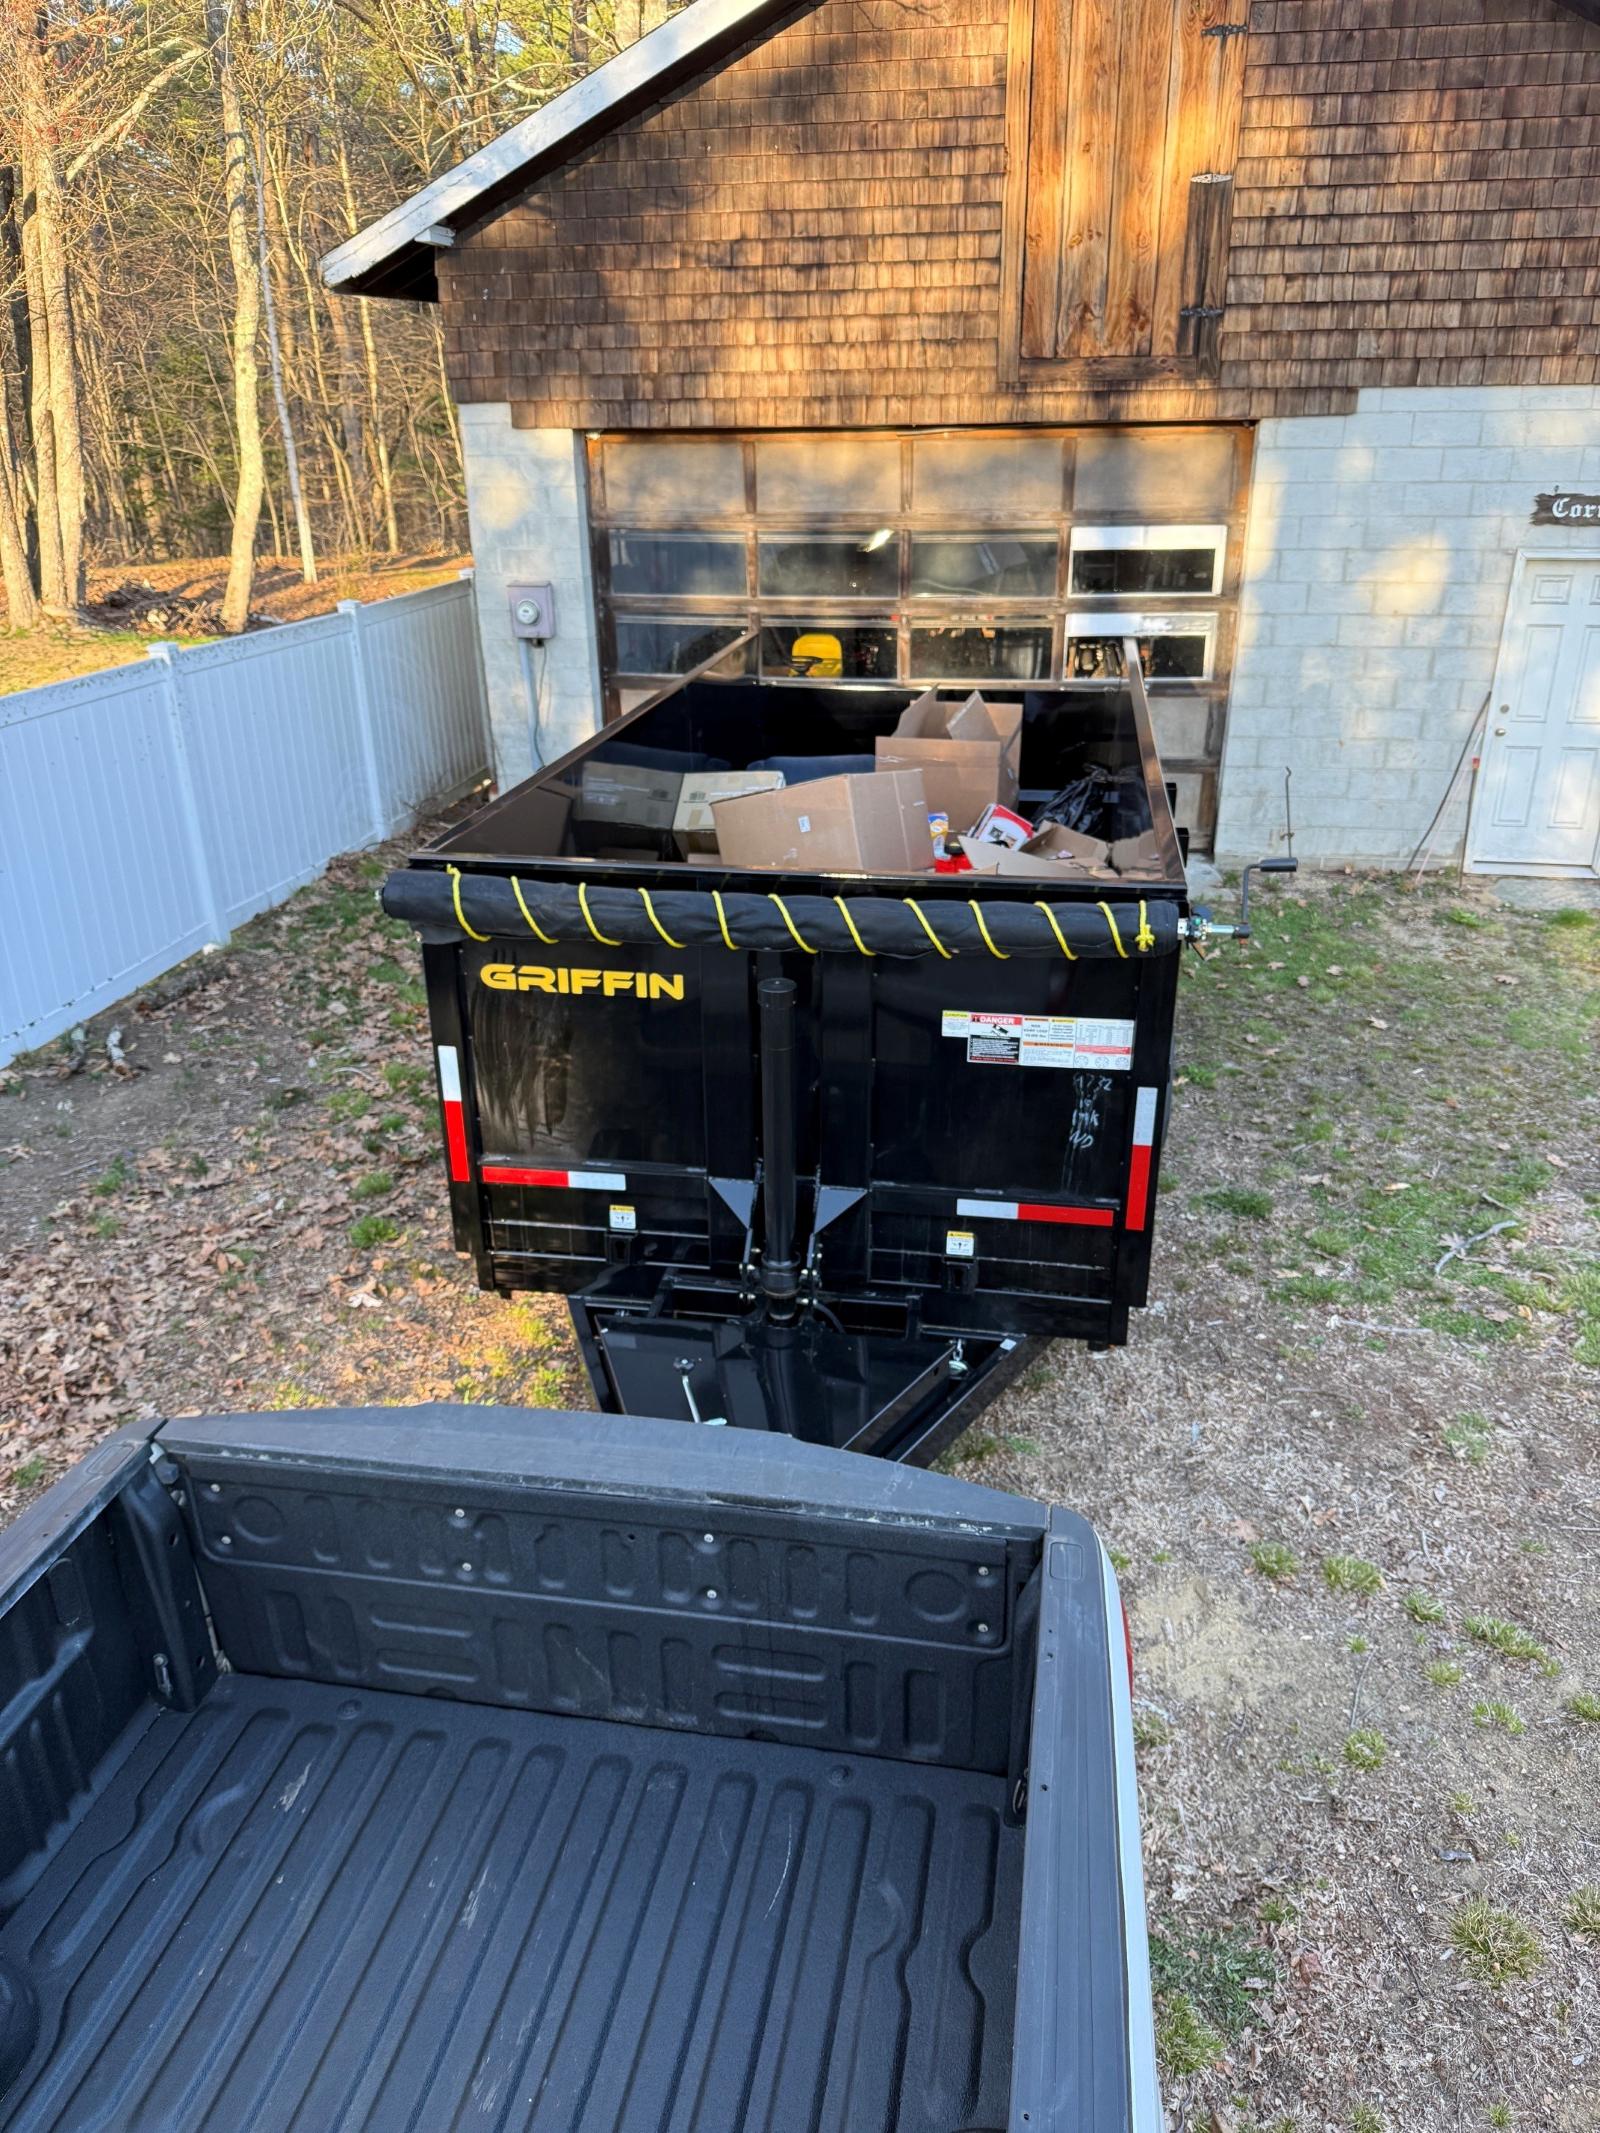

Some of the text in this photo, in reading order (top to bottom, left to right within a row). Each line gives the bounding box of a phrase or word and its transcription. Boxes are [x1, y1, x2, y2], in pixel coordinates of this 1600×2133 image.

[1551, 497, 1600, 519] Cor
[479, 963, 685, 1001] GRIFFIN
[979, 1016, 1015, 1025] DANGER
